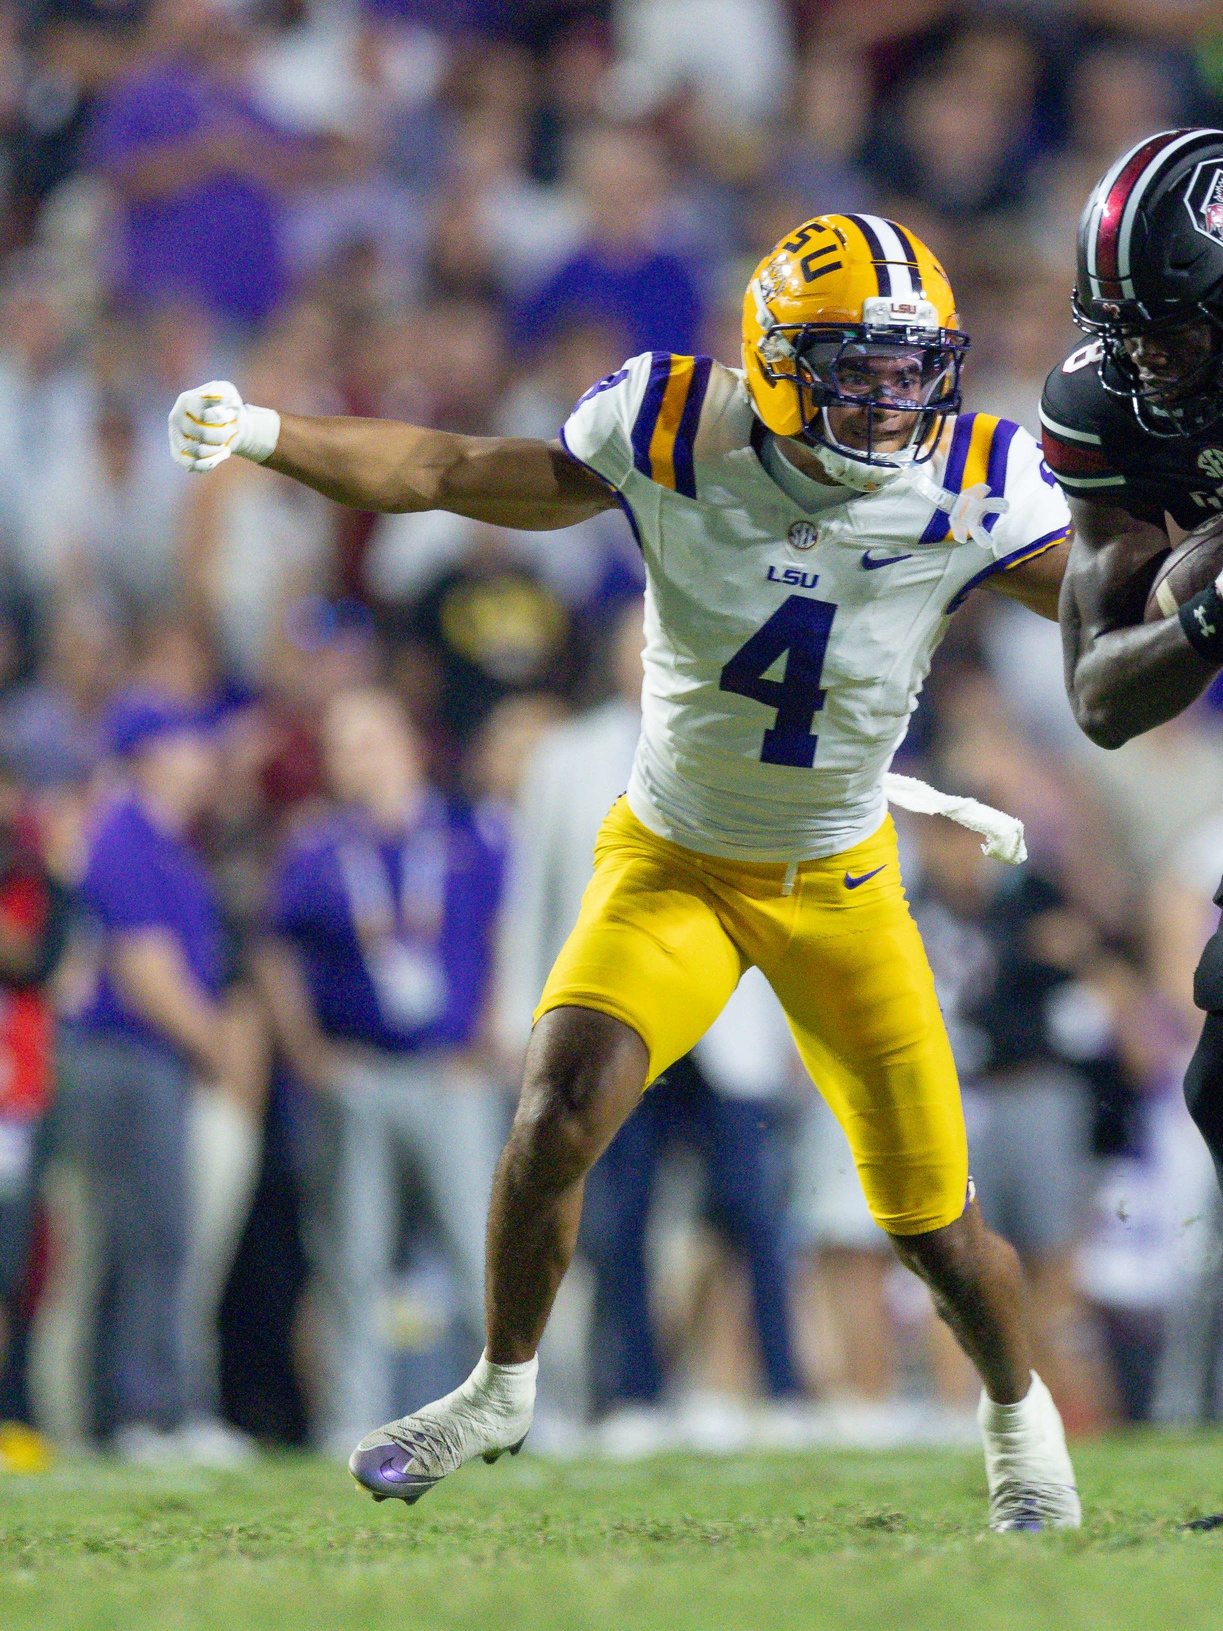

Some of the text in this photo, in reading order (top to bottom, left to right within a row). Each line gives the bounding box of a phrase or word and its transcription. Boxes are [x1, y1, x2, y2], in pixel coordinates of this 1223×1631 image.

[782, 223, 843, 283] SU
[890, 303, 917, 314] LSU
[767, 565, 820, 589] LSU
[719, 594, 838, 768] 4
